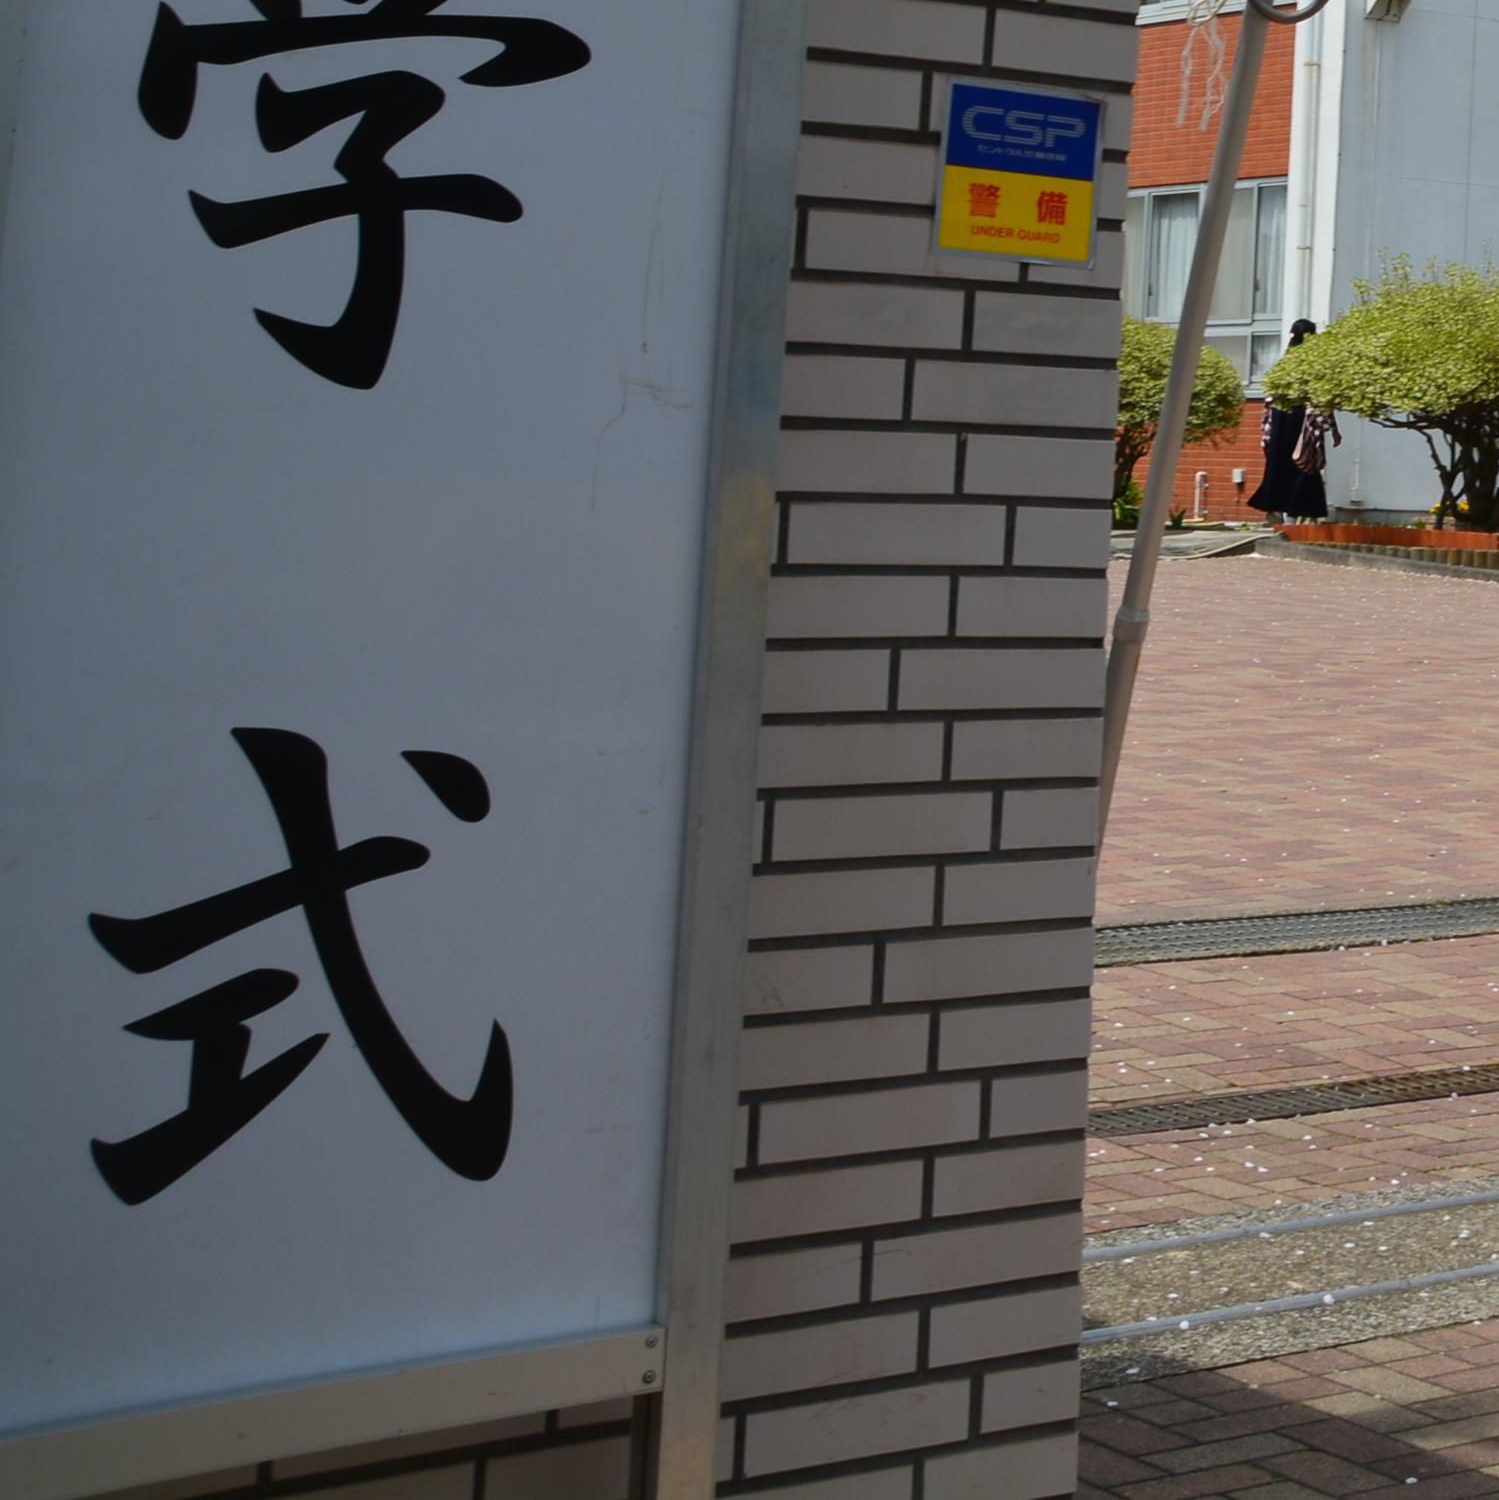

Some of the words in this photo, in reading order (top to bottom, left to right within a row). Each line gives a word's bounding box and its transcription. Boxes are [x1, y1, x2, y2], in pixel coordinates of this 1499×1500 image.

[962, 105, 1087, 148] CSP
[967, 181, 1070, 227] 警備
[970, 224, 1015, 239] UNDER
[1017, 228, 1062, 244] GUARD
